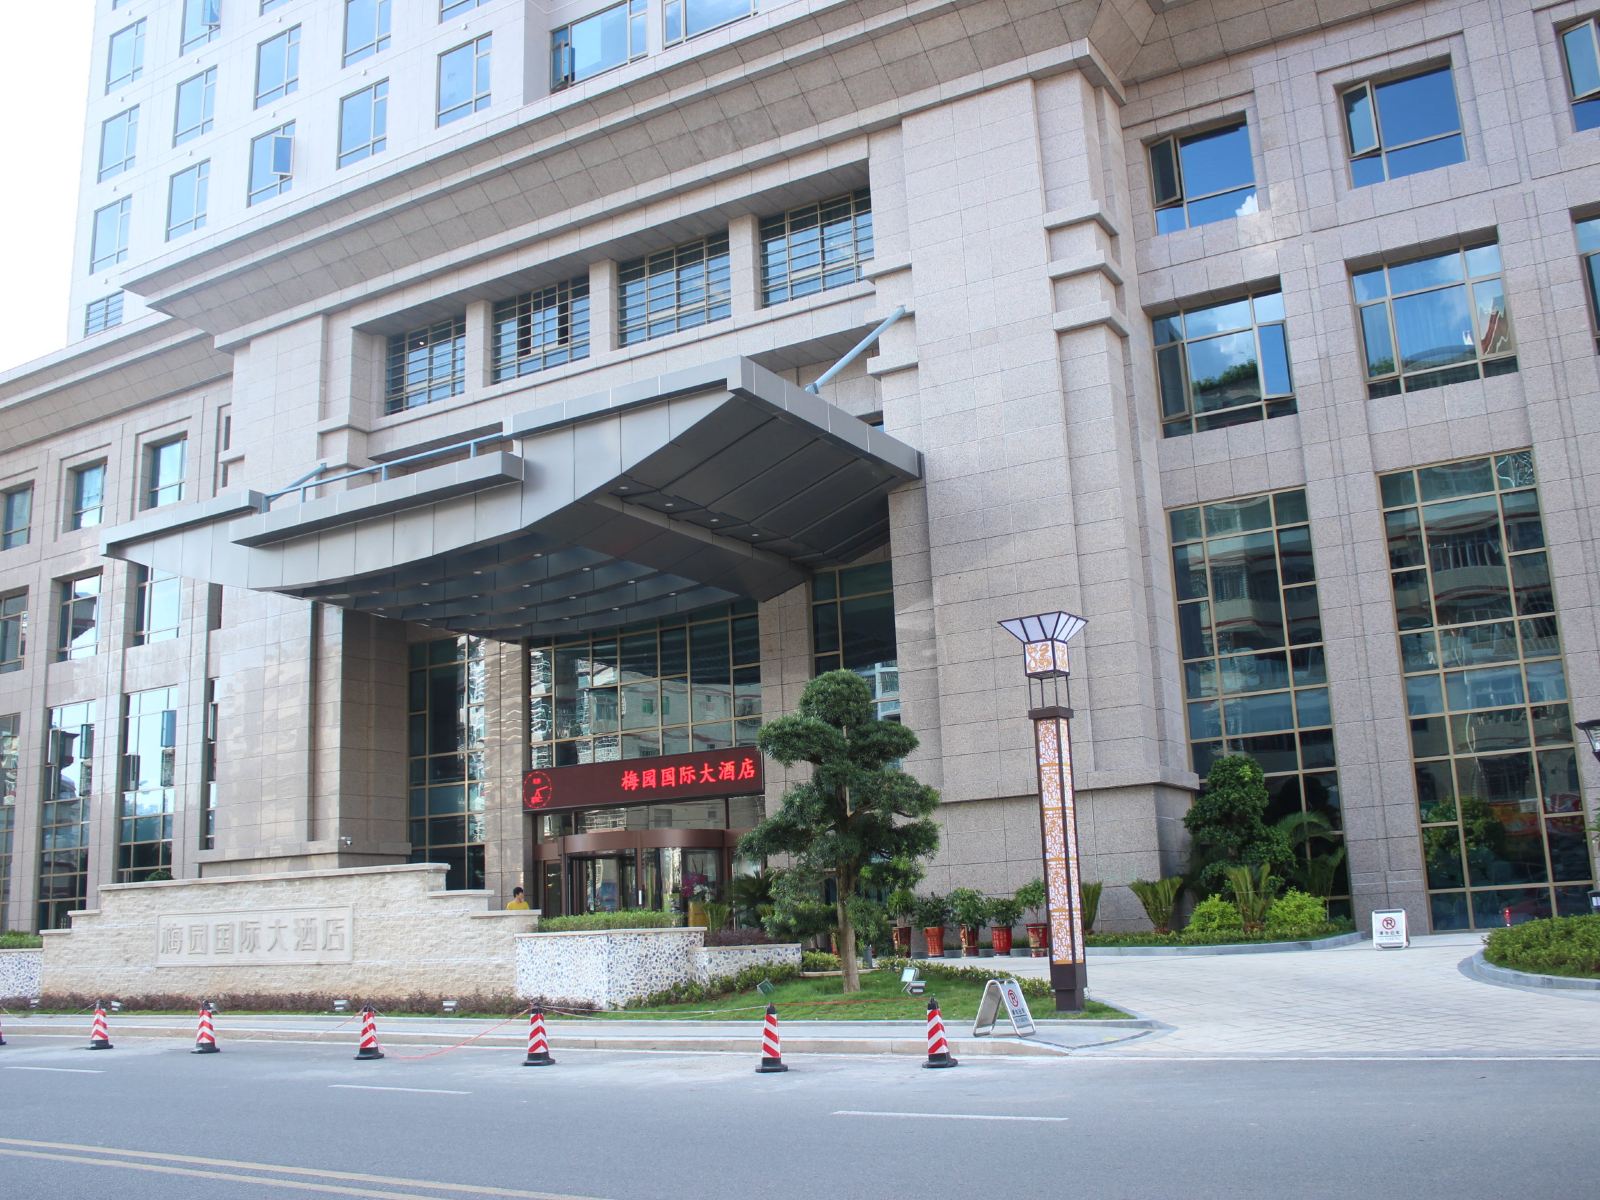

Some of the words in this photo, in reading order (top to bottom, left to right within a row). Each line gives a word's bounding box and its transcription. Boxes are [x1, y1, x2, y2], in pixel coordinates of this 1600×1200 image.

[621, 758, 755, 791] 梅园国际大酒店
[160, 917, 345, 955] 梅园国际大酒店
